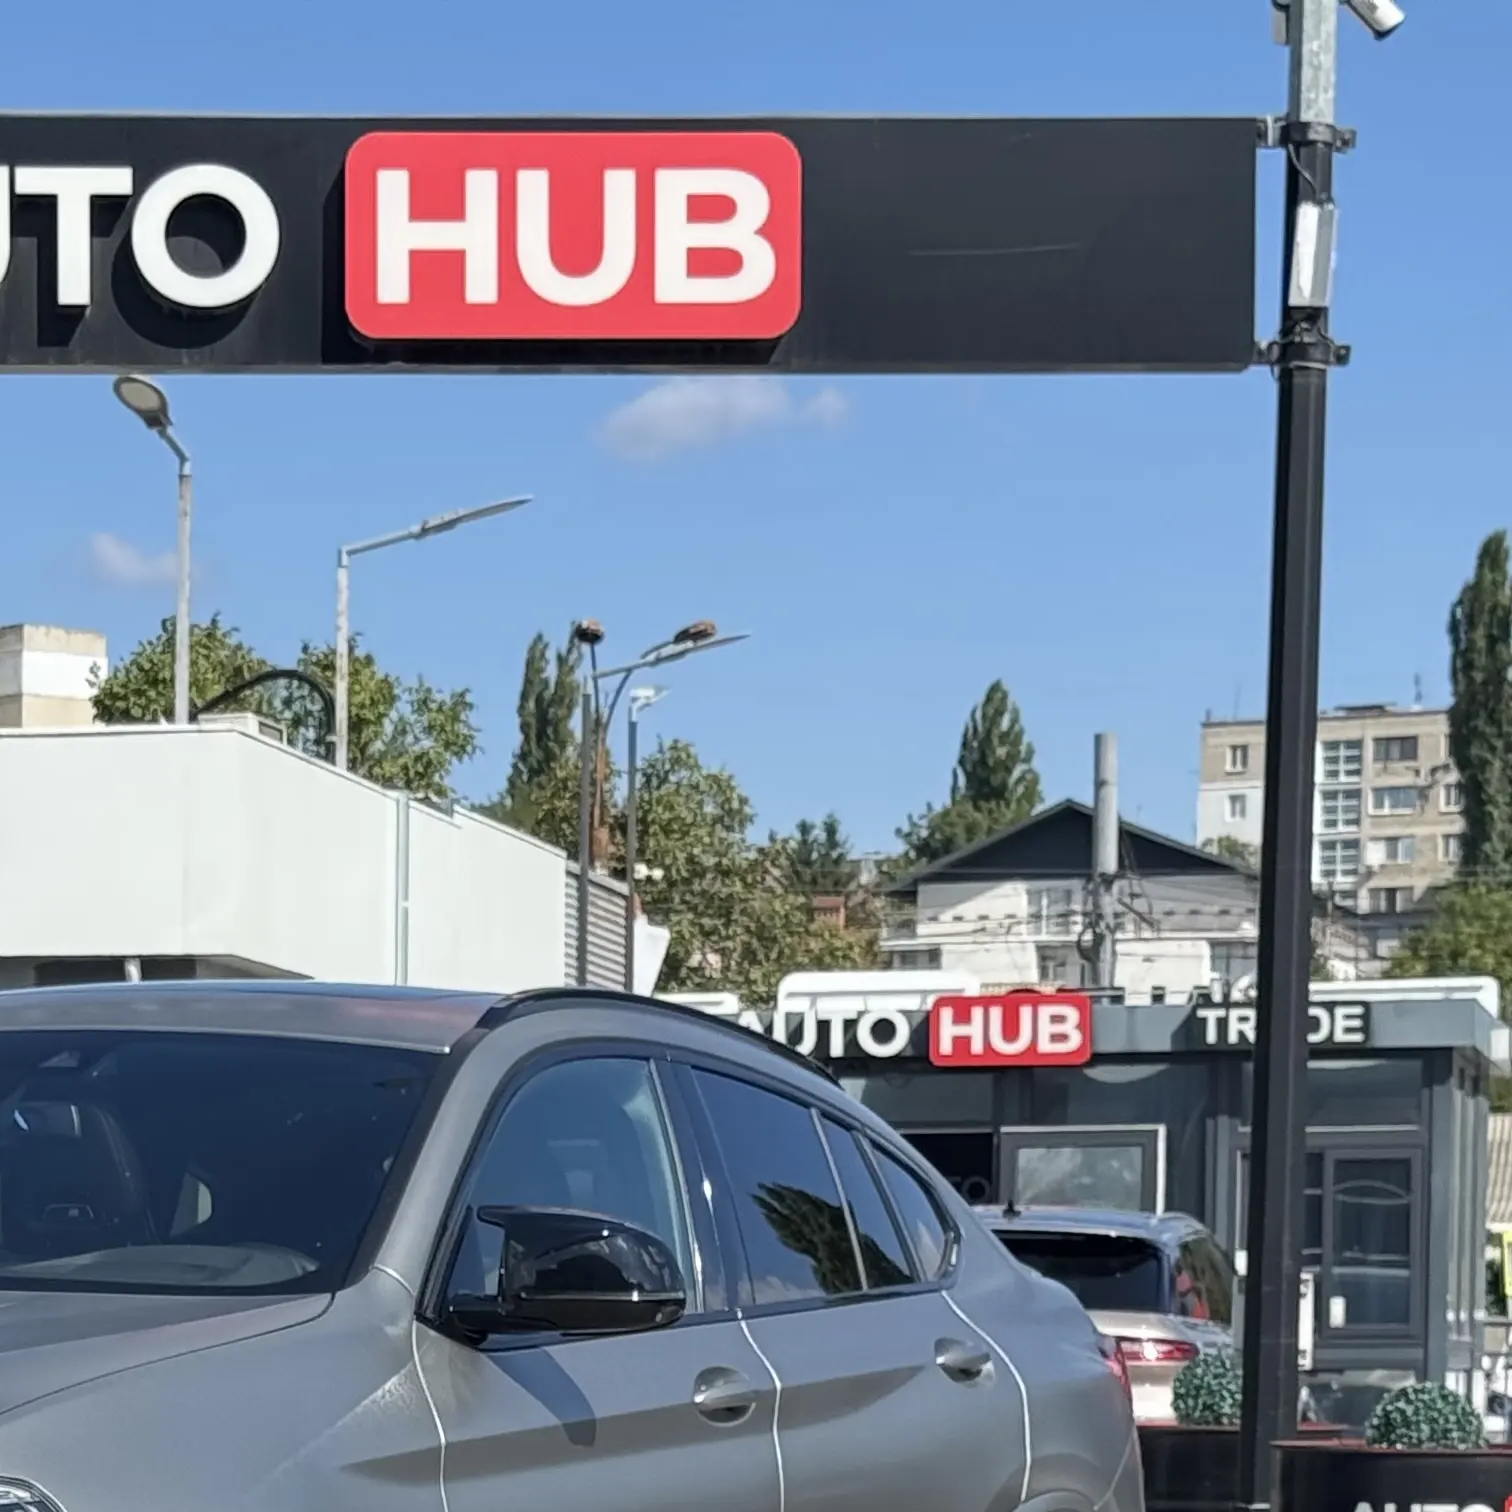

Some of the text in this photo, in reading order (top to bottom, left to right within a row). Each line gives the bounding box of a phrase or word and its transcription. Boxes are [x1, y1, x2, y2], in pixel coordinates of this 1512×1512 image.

[375, 168, 778, 307] HUB
[938, 1004, 1084, 1056] HUB
[1195, 1005, 1366, 1045] TRDE
